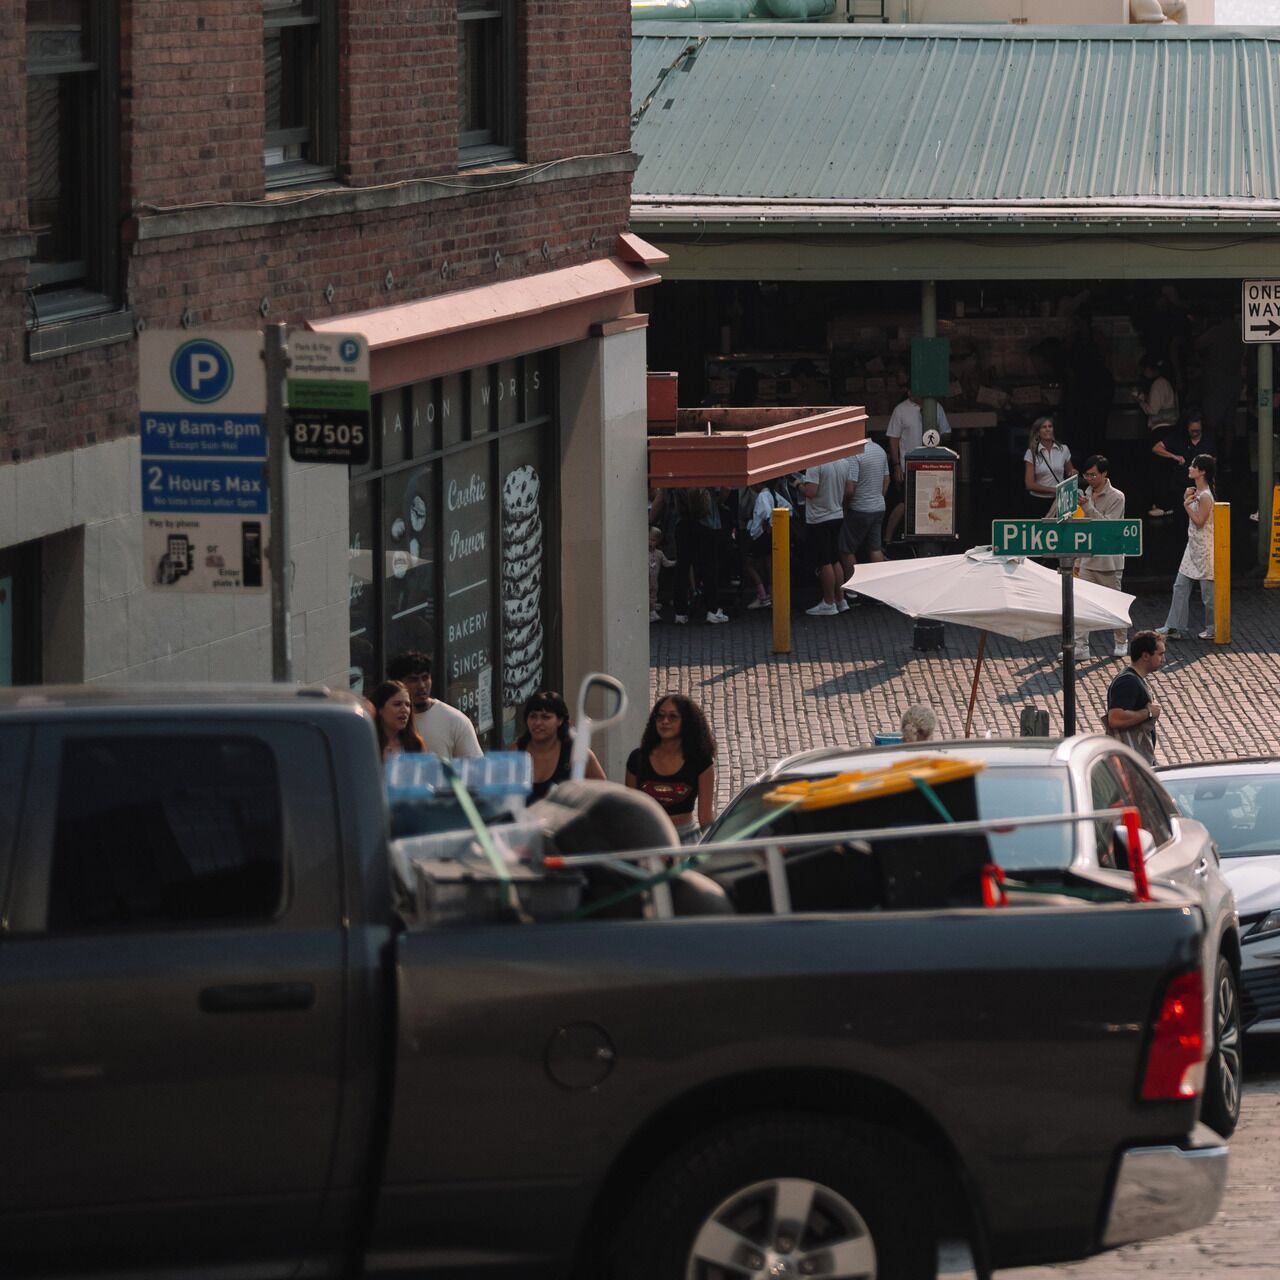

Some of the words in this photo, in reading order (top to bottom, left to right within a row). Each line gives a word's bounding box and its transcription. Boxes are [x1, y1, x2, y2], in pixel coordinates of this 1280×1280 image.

[145, 418, 177, 438] Pay
[295, 423, 364, 444] 87505
[148, 466, 163, 491] 2
[168, 474, 222, 492] Hours
[226, 475, 261, 493] Max
[447, 473, 486, 511] Cookie
[449, 529, 487, 562] Power
[1003, 524, 1058, 550] Pike
[1075, 532, 1092, 550] Pl
[1123, 525, 1138, 537] 60
[449, 611, 488, 642] BAKERY
[453, 649, 486, 679] SINCE
